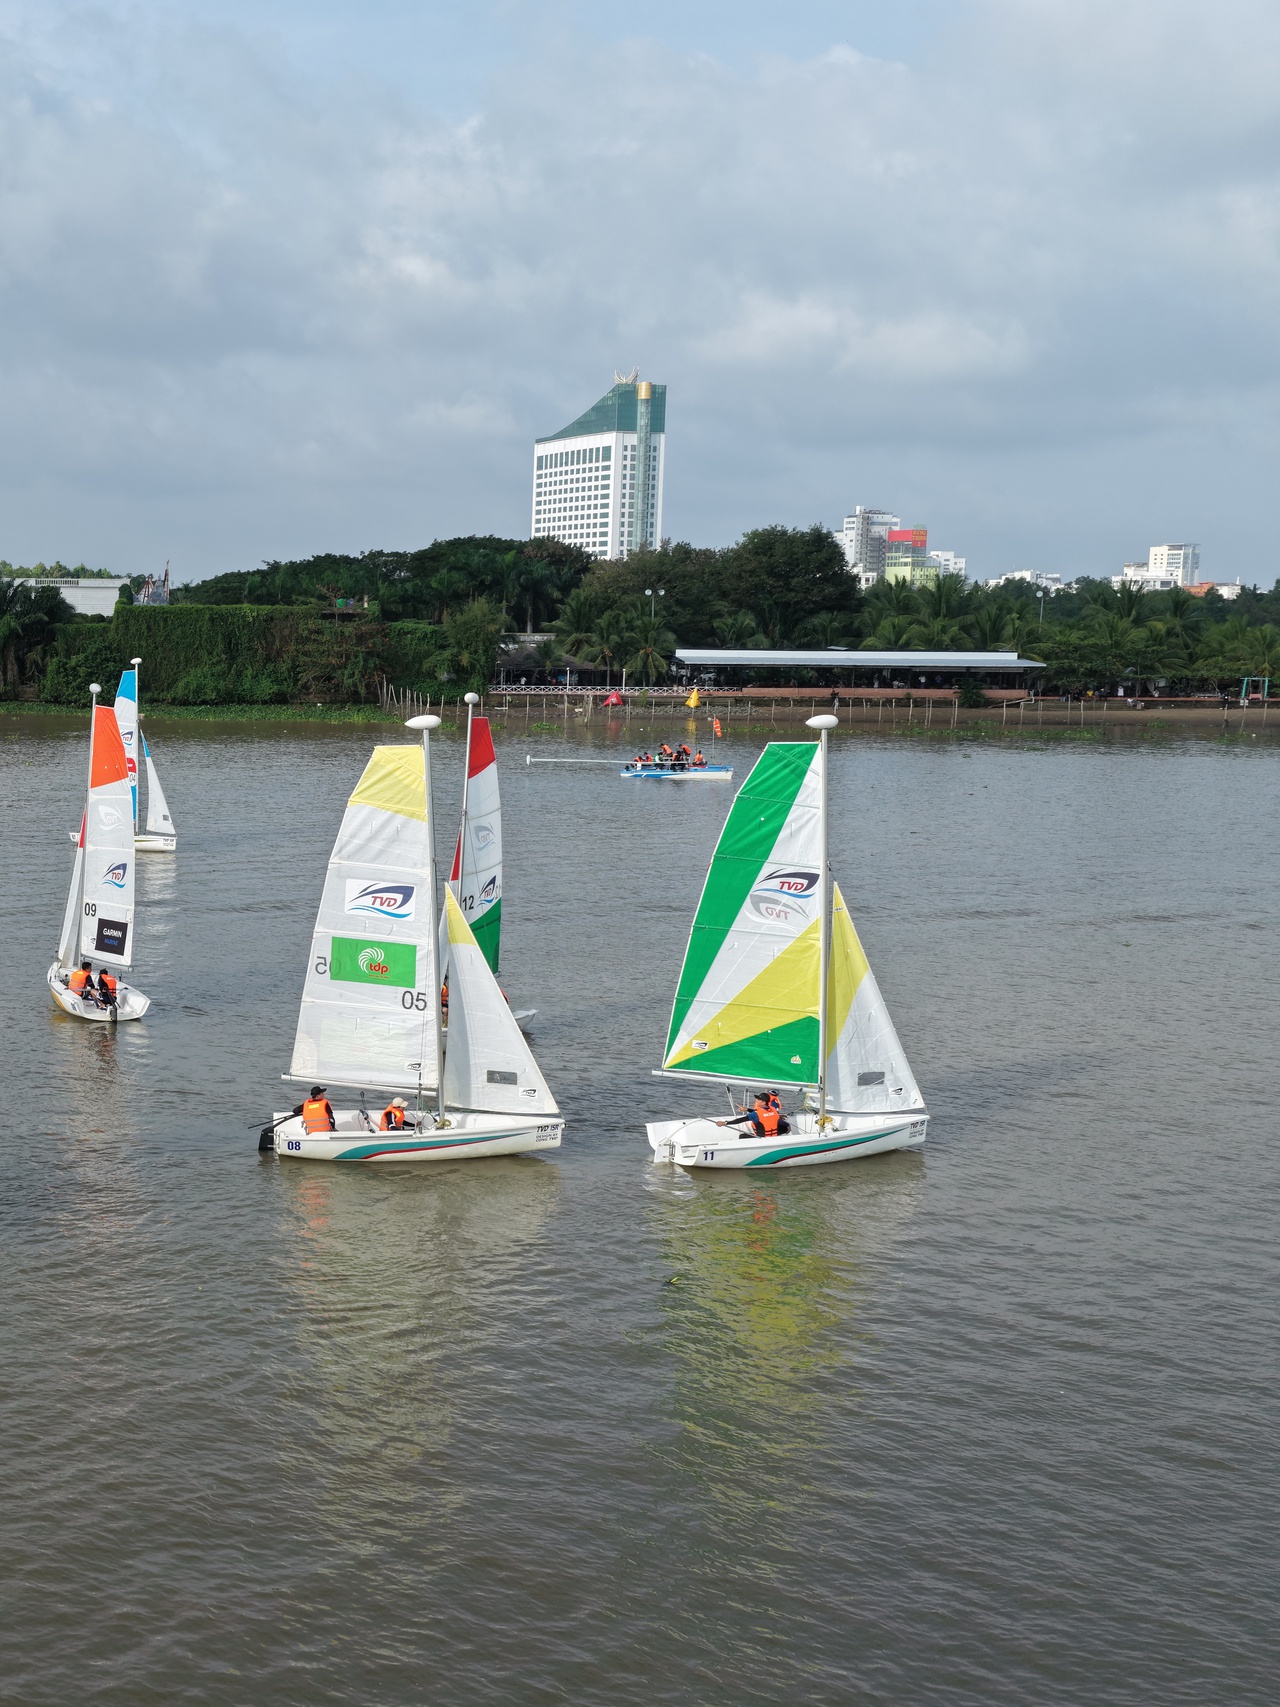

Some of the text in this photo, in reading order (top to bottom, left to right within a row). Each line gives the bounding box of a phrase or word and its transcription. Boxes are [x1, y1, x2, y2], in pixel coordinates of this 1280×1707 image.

[111, 872, 121, 881] TVD
[779, 881, 805, 891] TVD
[371, 896, 397, 907] TVD
[462, 895, 474, 911] 12
[84, 903, 97, 917] 09
[103, 928, 122, 938] GARMIN
[369, 962, 389, 974] tdp
[402, 990, 427, 1011] 05
[287, 1141, 301, 1151] 08
[703, 1151, 715, 1161] 11
